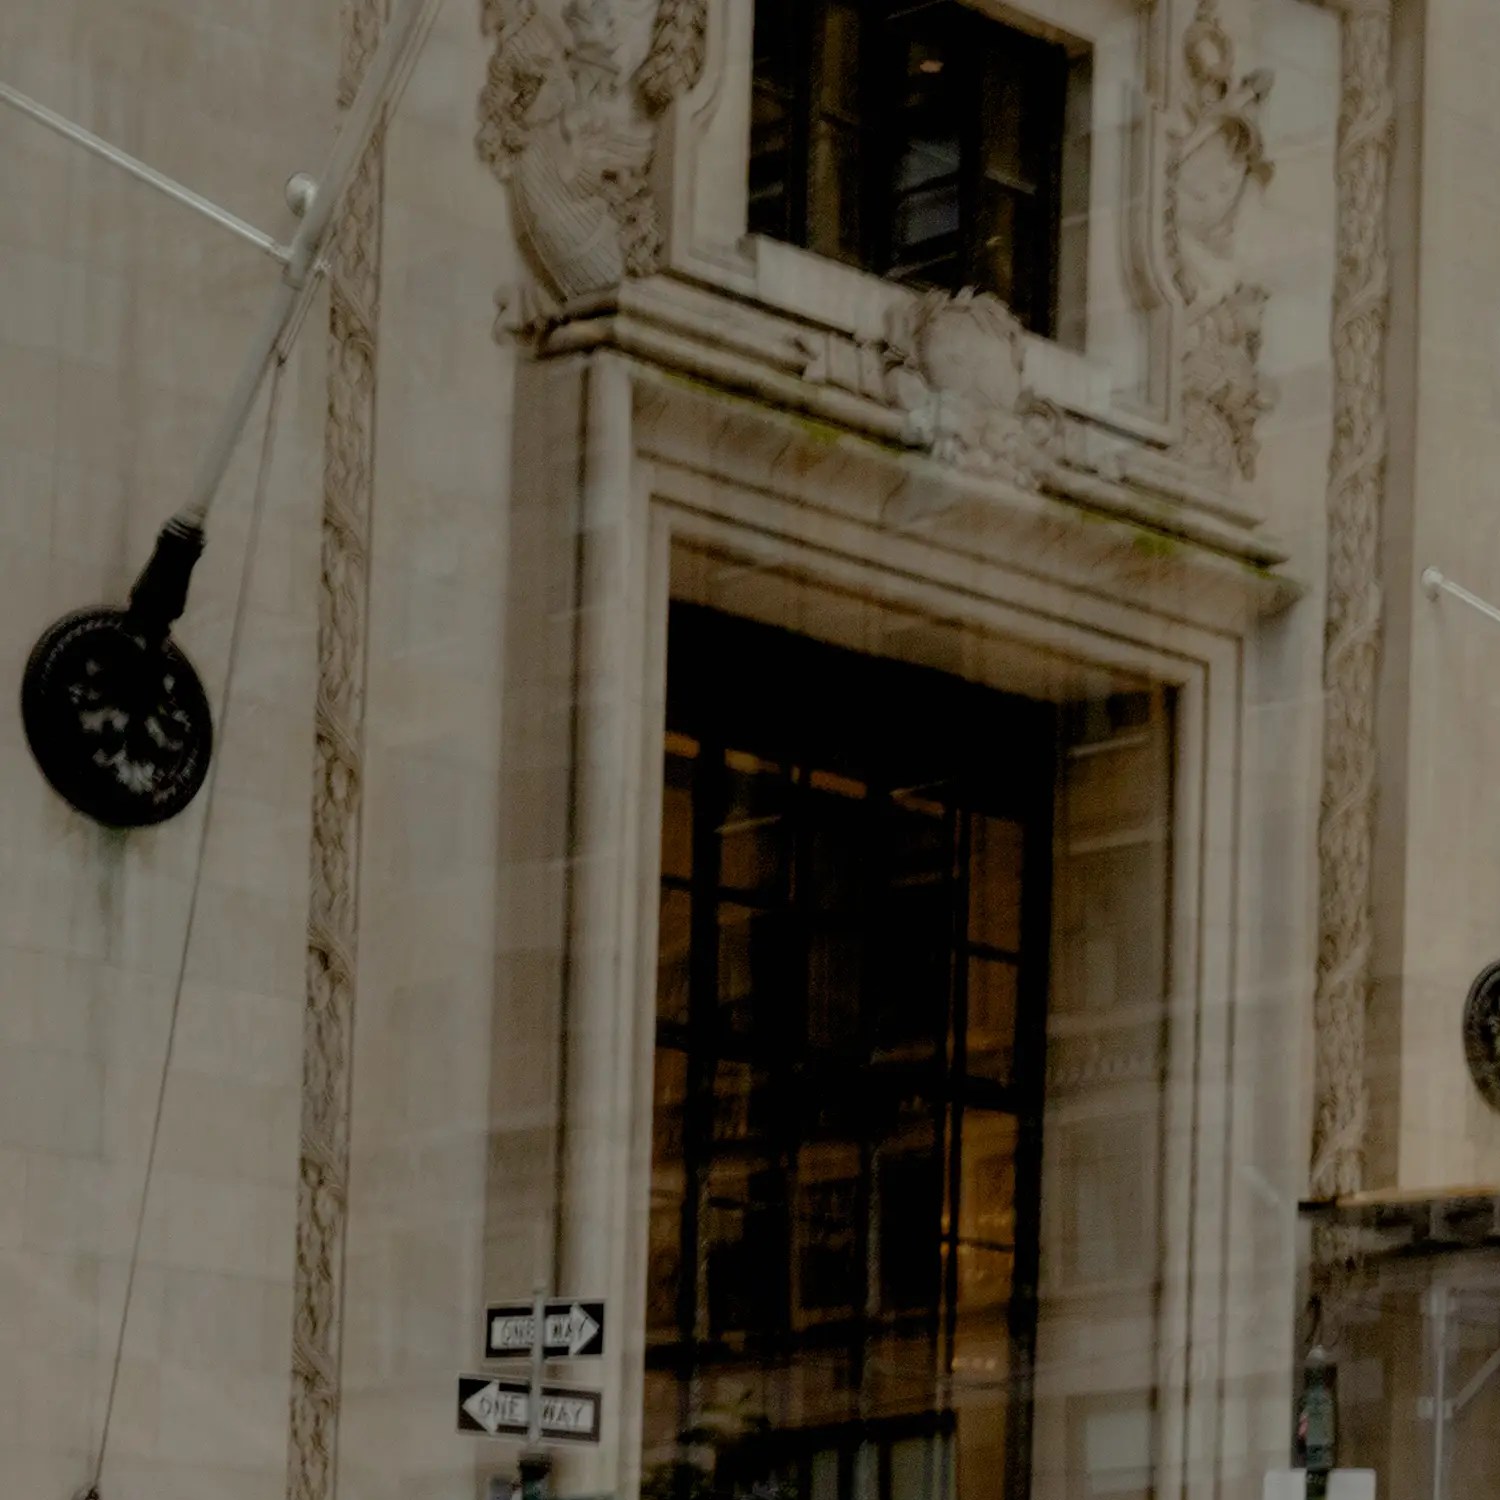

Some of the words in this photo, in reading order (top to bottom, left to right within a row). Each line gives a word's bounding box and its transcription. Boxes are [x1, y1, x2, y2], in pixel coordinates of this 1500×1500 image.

[548, 1314, 590, 1345] WAY
[479, 1395, 523, 1423] ONE
[541, 1398, 587, 1428] WAY
